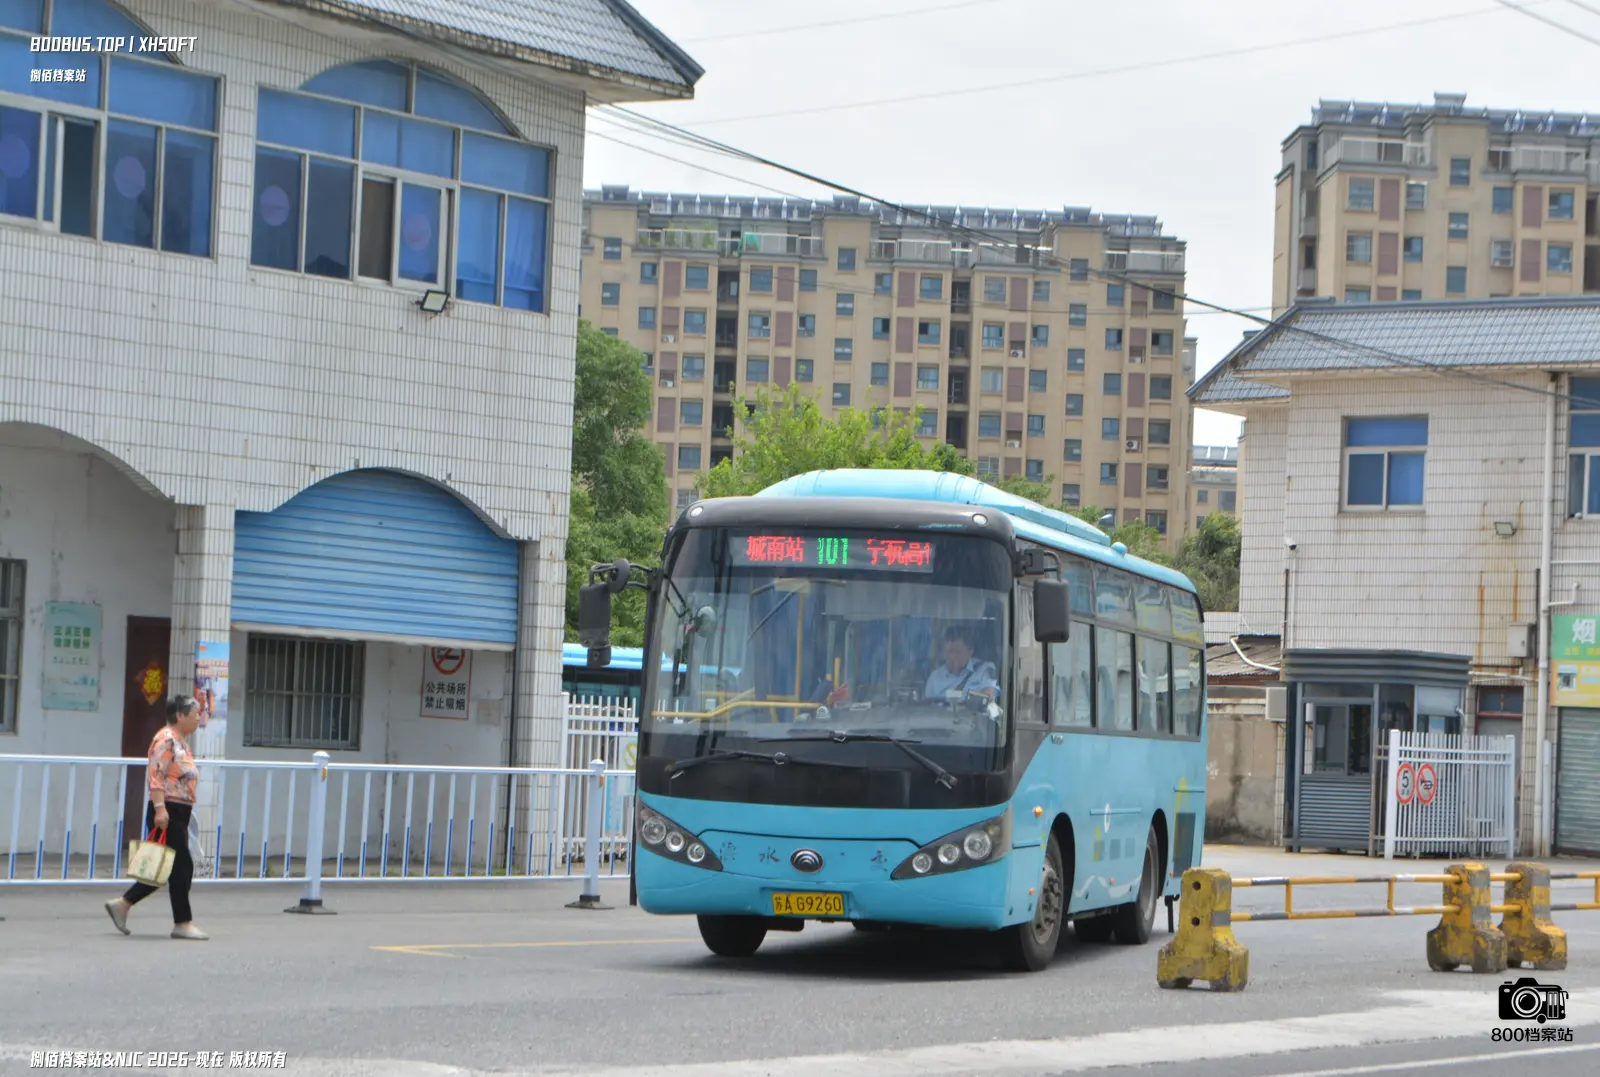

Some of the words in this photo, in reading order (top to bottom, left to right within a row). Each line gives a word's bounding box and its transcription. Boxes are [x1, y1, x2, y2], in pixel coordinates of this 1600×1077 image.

[746, 535, 805, 562] 城南站
[1572, 617, 1596, 644] 烟
[426, 681, 467, 696] 公共场所
[425, 696, 466, 711] 禁止吸烟
[1402, 769, 1410, 788] 5
